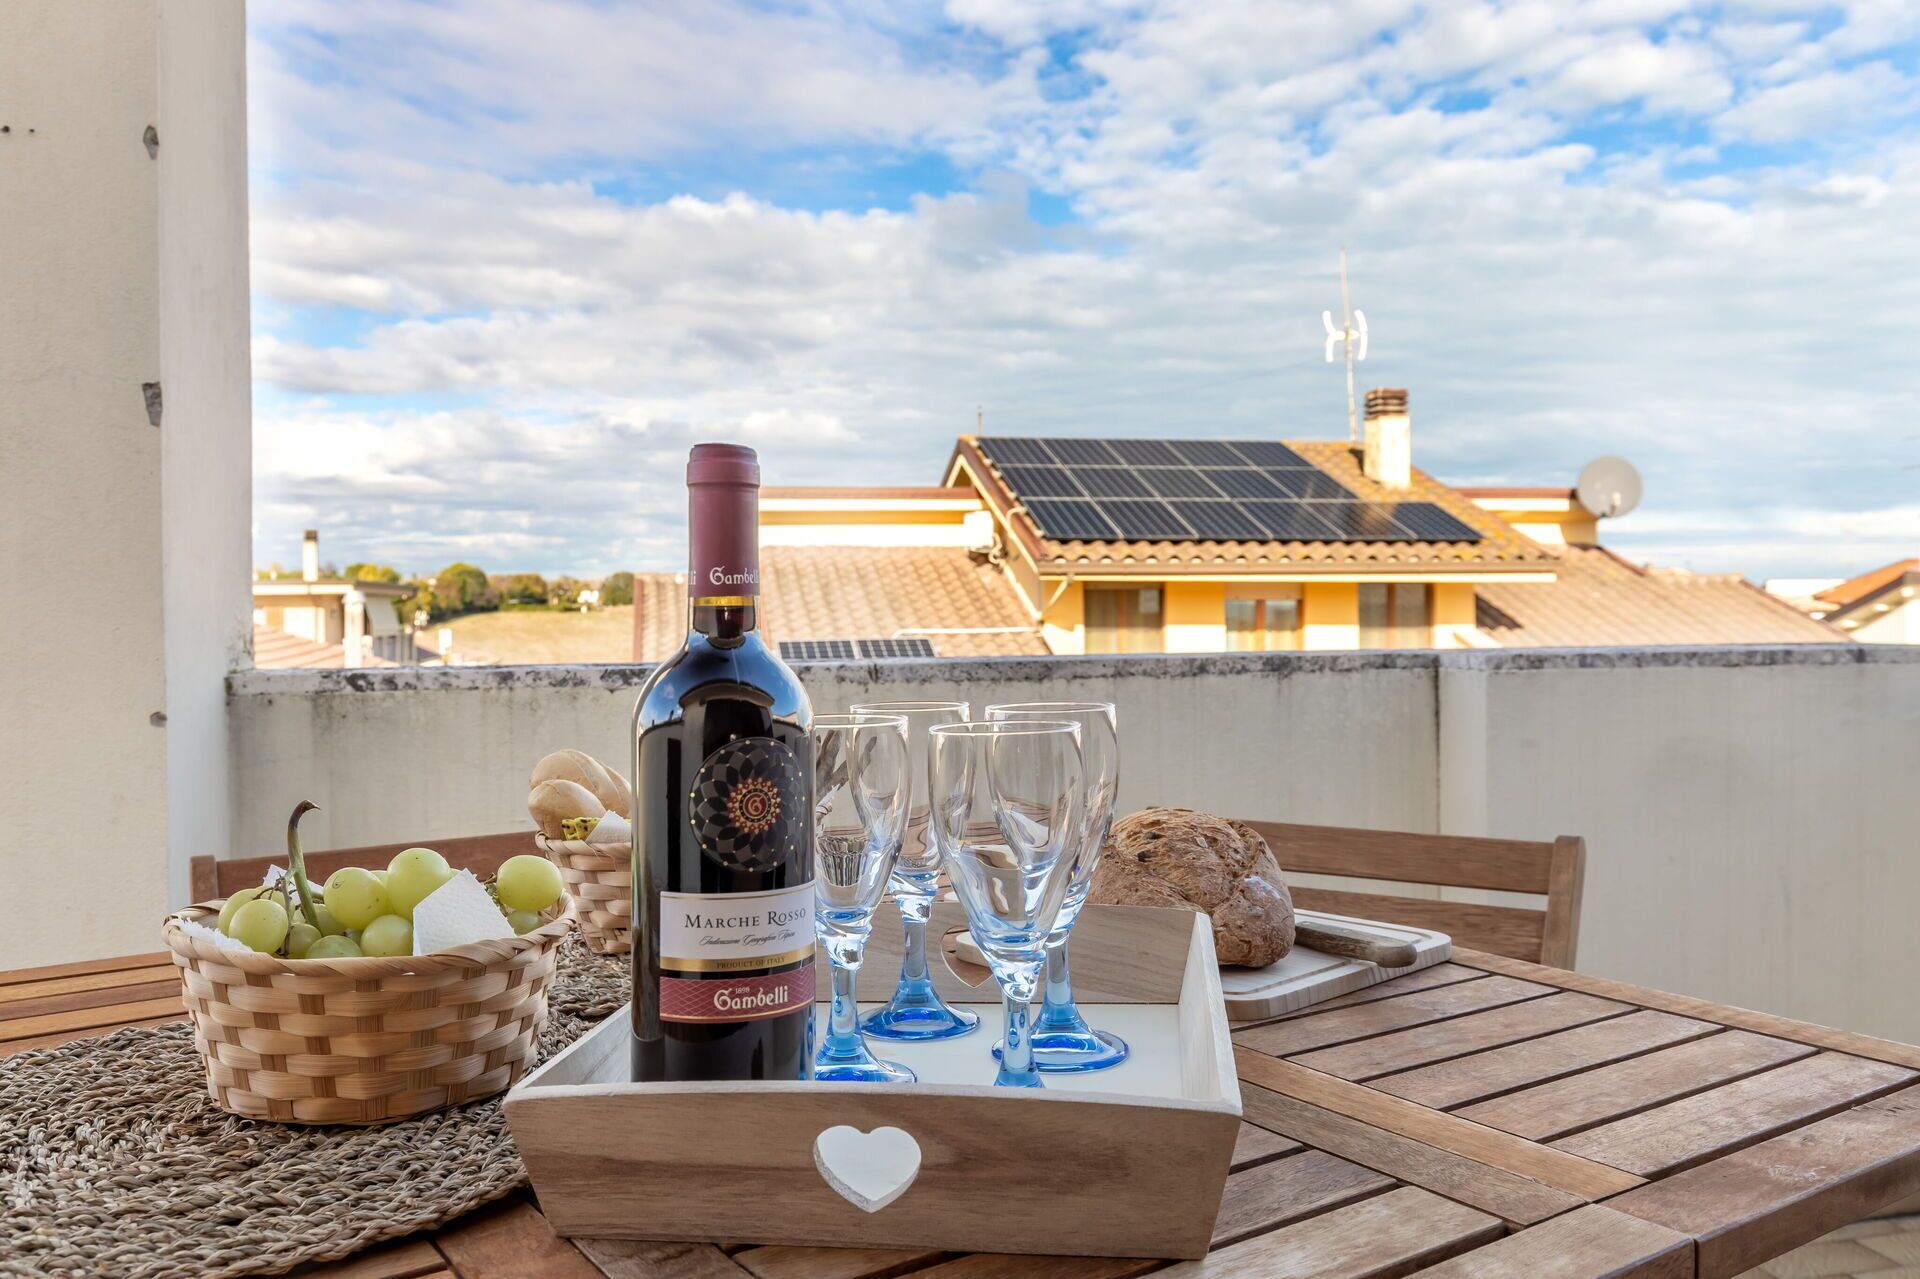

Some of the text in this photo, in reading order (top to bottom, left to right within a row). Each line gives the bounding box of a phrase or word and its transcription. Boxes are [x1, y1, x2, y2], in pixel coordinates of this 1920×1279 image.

[684, 907, 806, 929] MARCHE ROSSO
[716, 956, 786, 970] PRODUCT OF ITALY
[713, 985, 789, 1011] Gambelli
